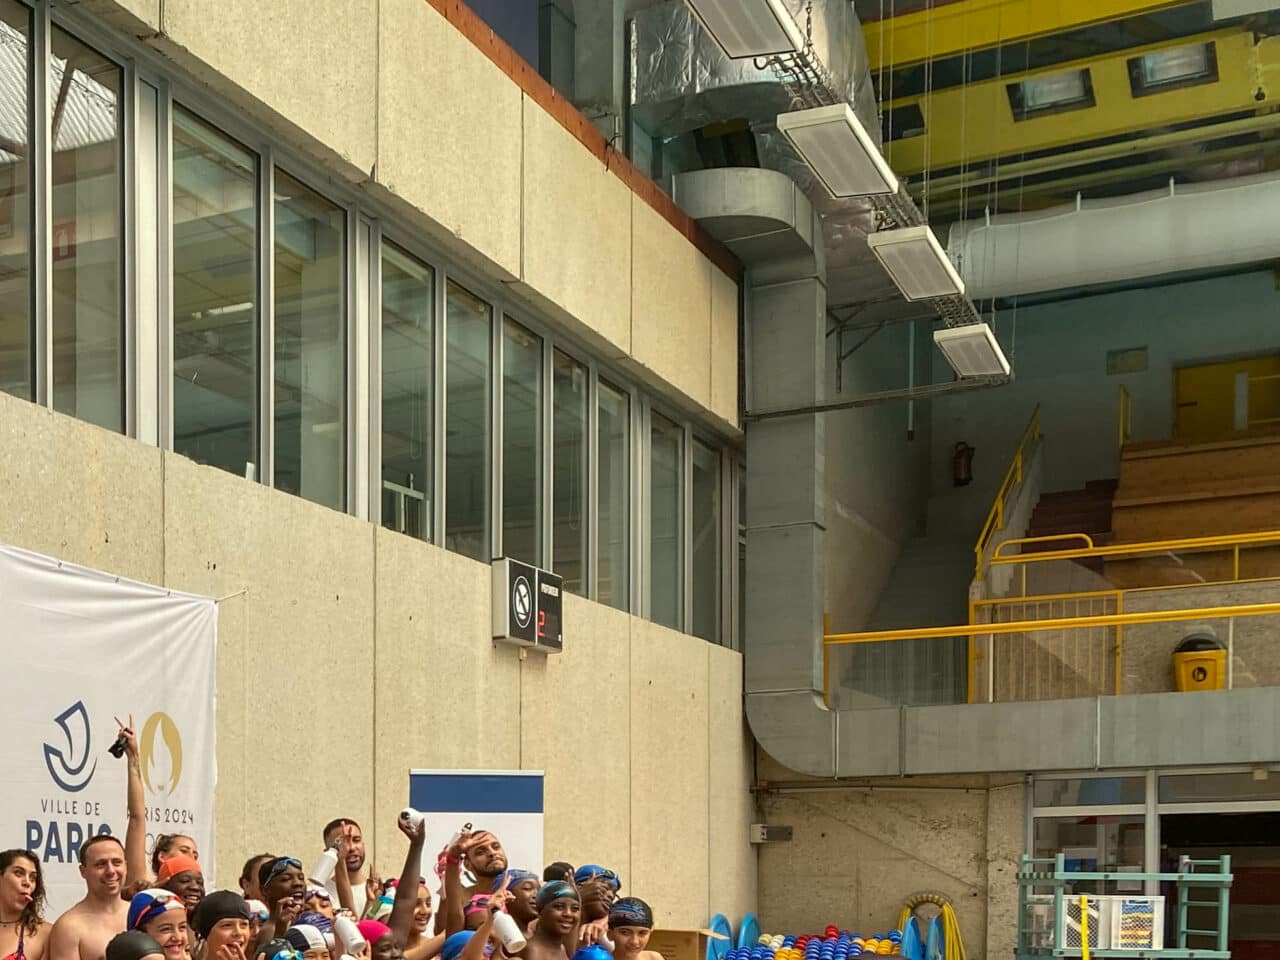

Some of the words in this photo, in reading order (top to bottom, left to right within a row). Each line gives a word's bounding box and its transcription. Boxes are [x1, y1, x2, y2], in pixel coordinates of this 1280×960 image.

[41, 799, 78, 815] VILLE
[84, 802, 101, 816] DE
[164, 808, 194, 824] 2024
